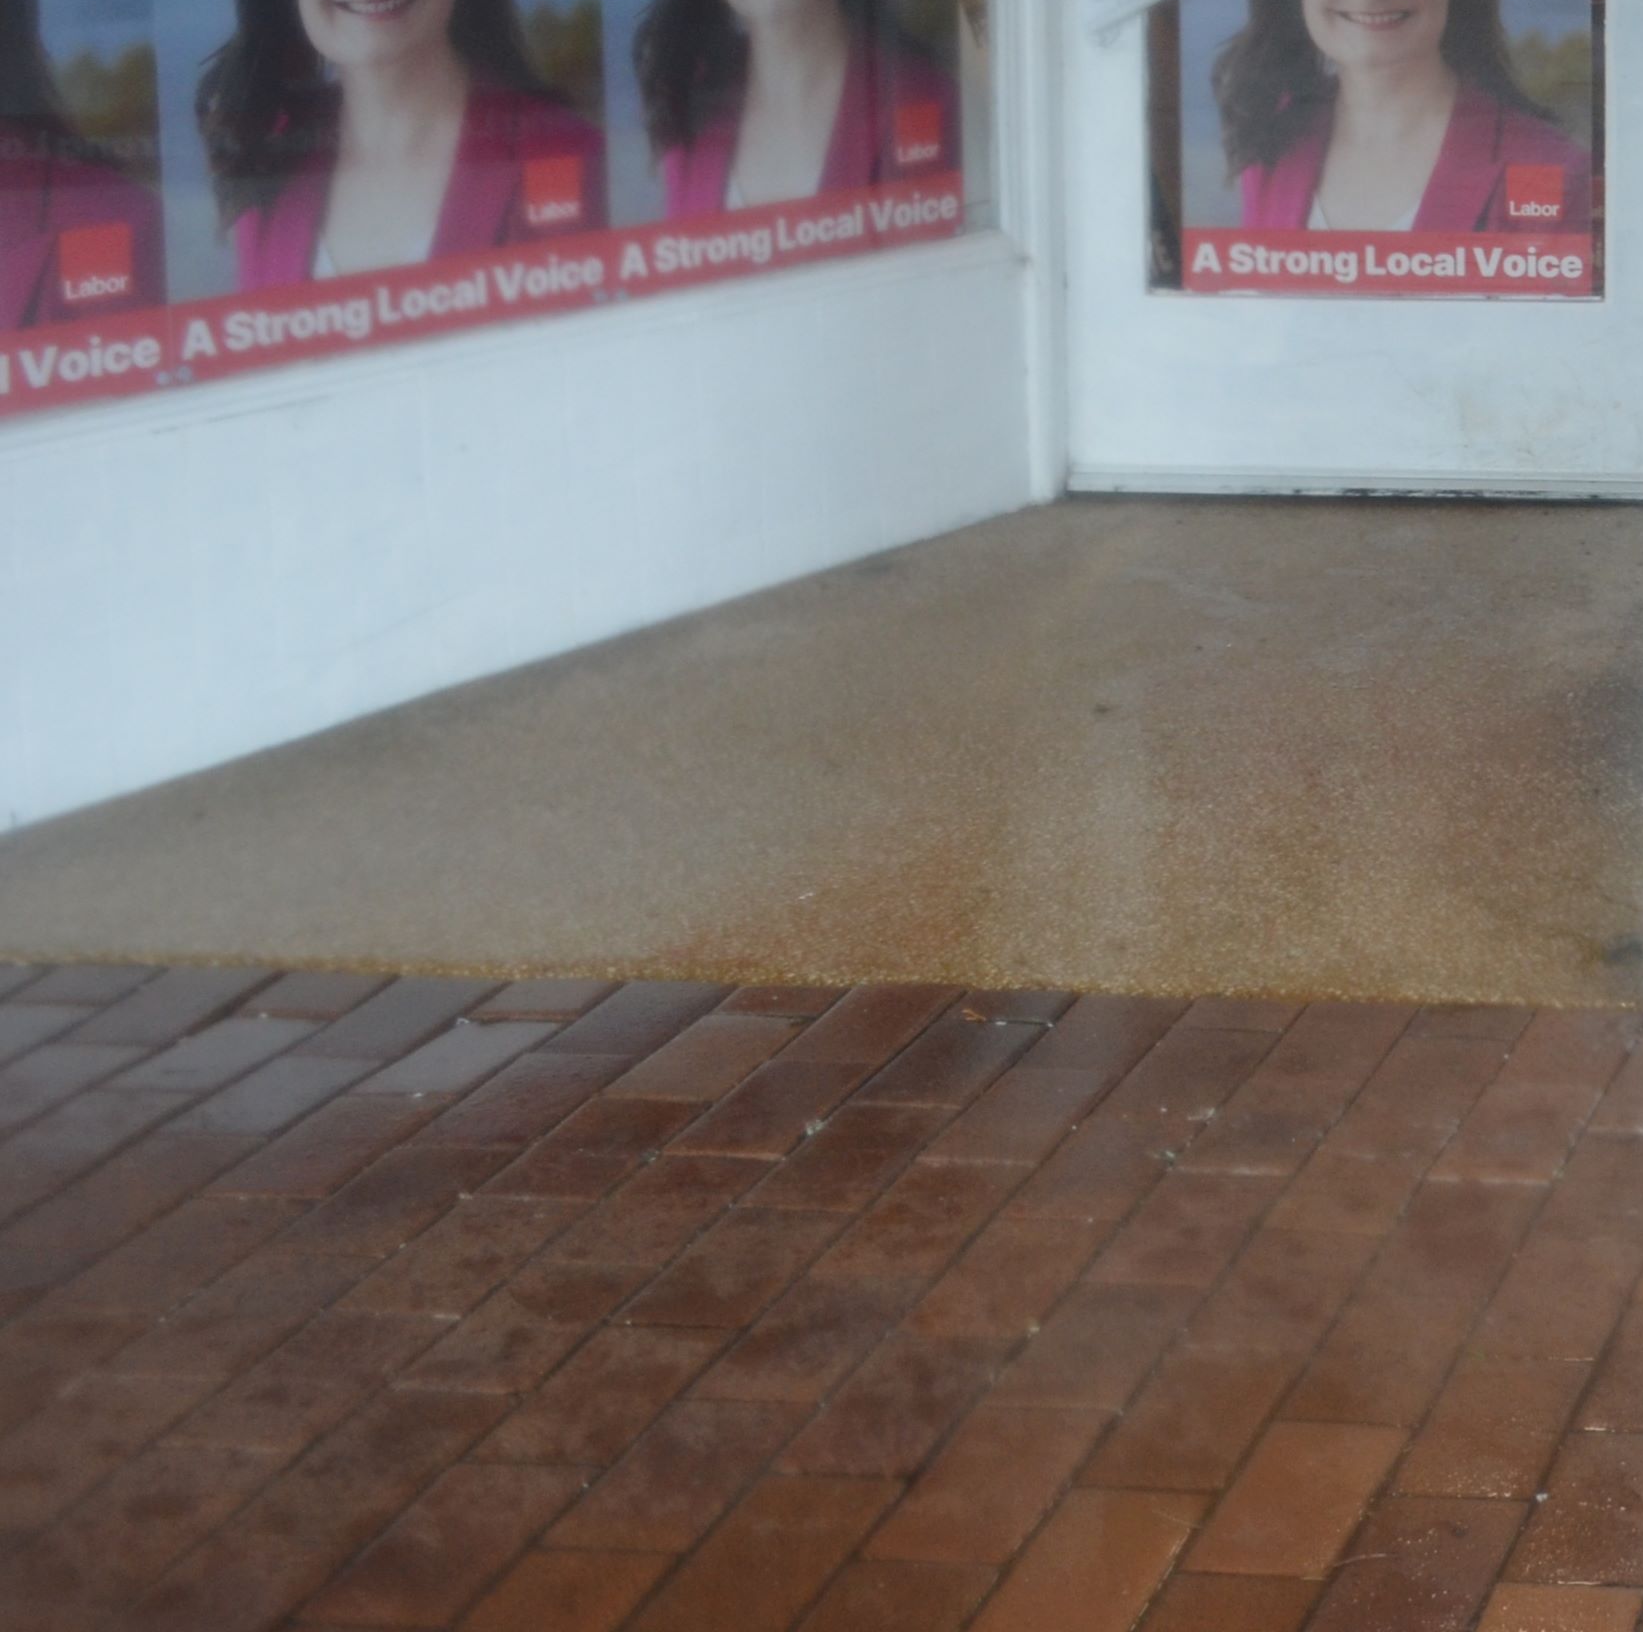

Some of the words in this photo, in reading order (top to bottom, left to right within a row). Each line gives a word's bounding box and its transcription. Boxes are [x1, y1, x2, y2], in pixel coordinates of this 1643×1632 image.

[896, 142, 939, 164] Labor
[527, 200, 581, 224] Labor
[1509, 201, 1560, 218] Labor
[620, 243, 649, 281] A
[654, 231, 773, 264] Strong
[777, 205, 863, 251] Local
[870, 193, 958, 234] Voice
[1193, 244, 1222, 274] A
[1229, 244, 1358, 282] Strong
[1366, 248, 1466, 278] Local
[1474, 246, 1584, 280] Voice
[63, 275, 129, 301] Labor
[183, 320, 216, 360] A
[224, 297, 371, 353] Strong
[377, 271, 487, 322] Local
[495, 254, 605, 304] Voice
[18, 335, 161, 390] Voice
